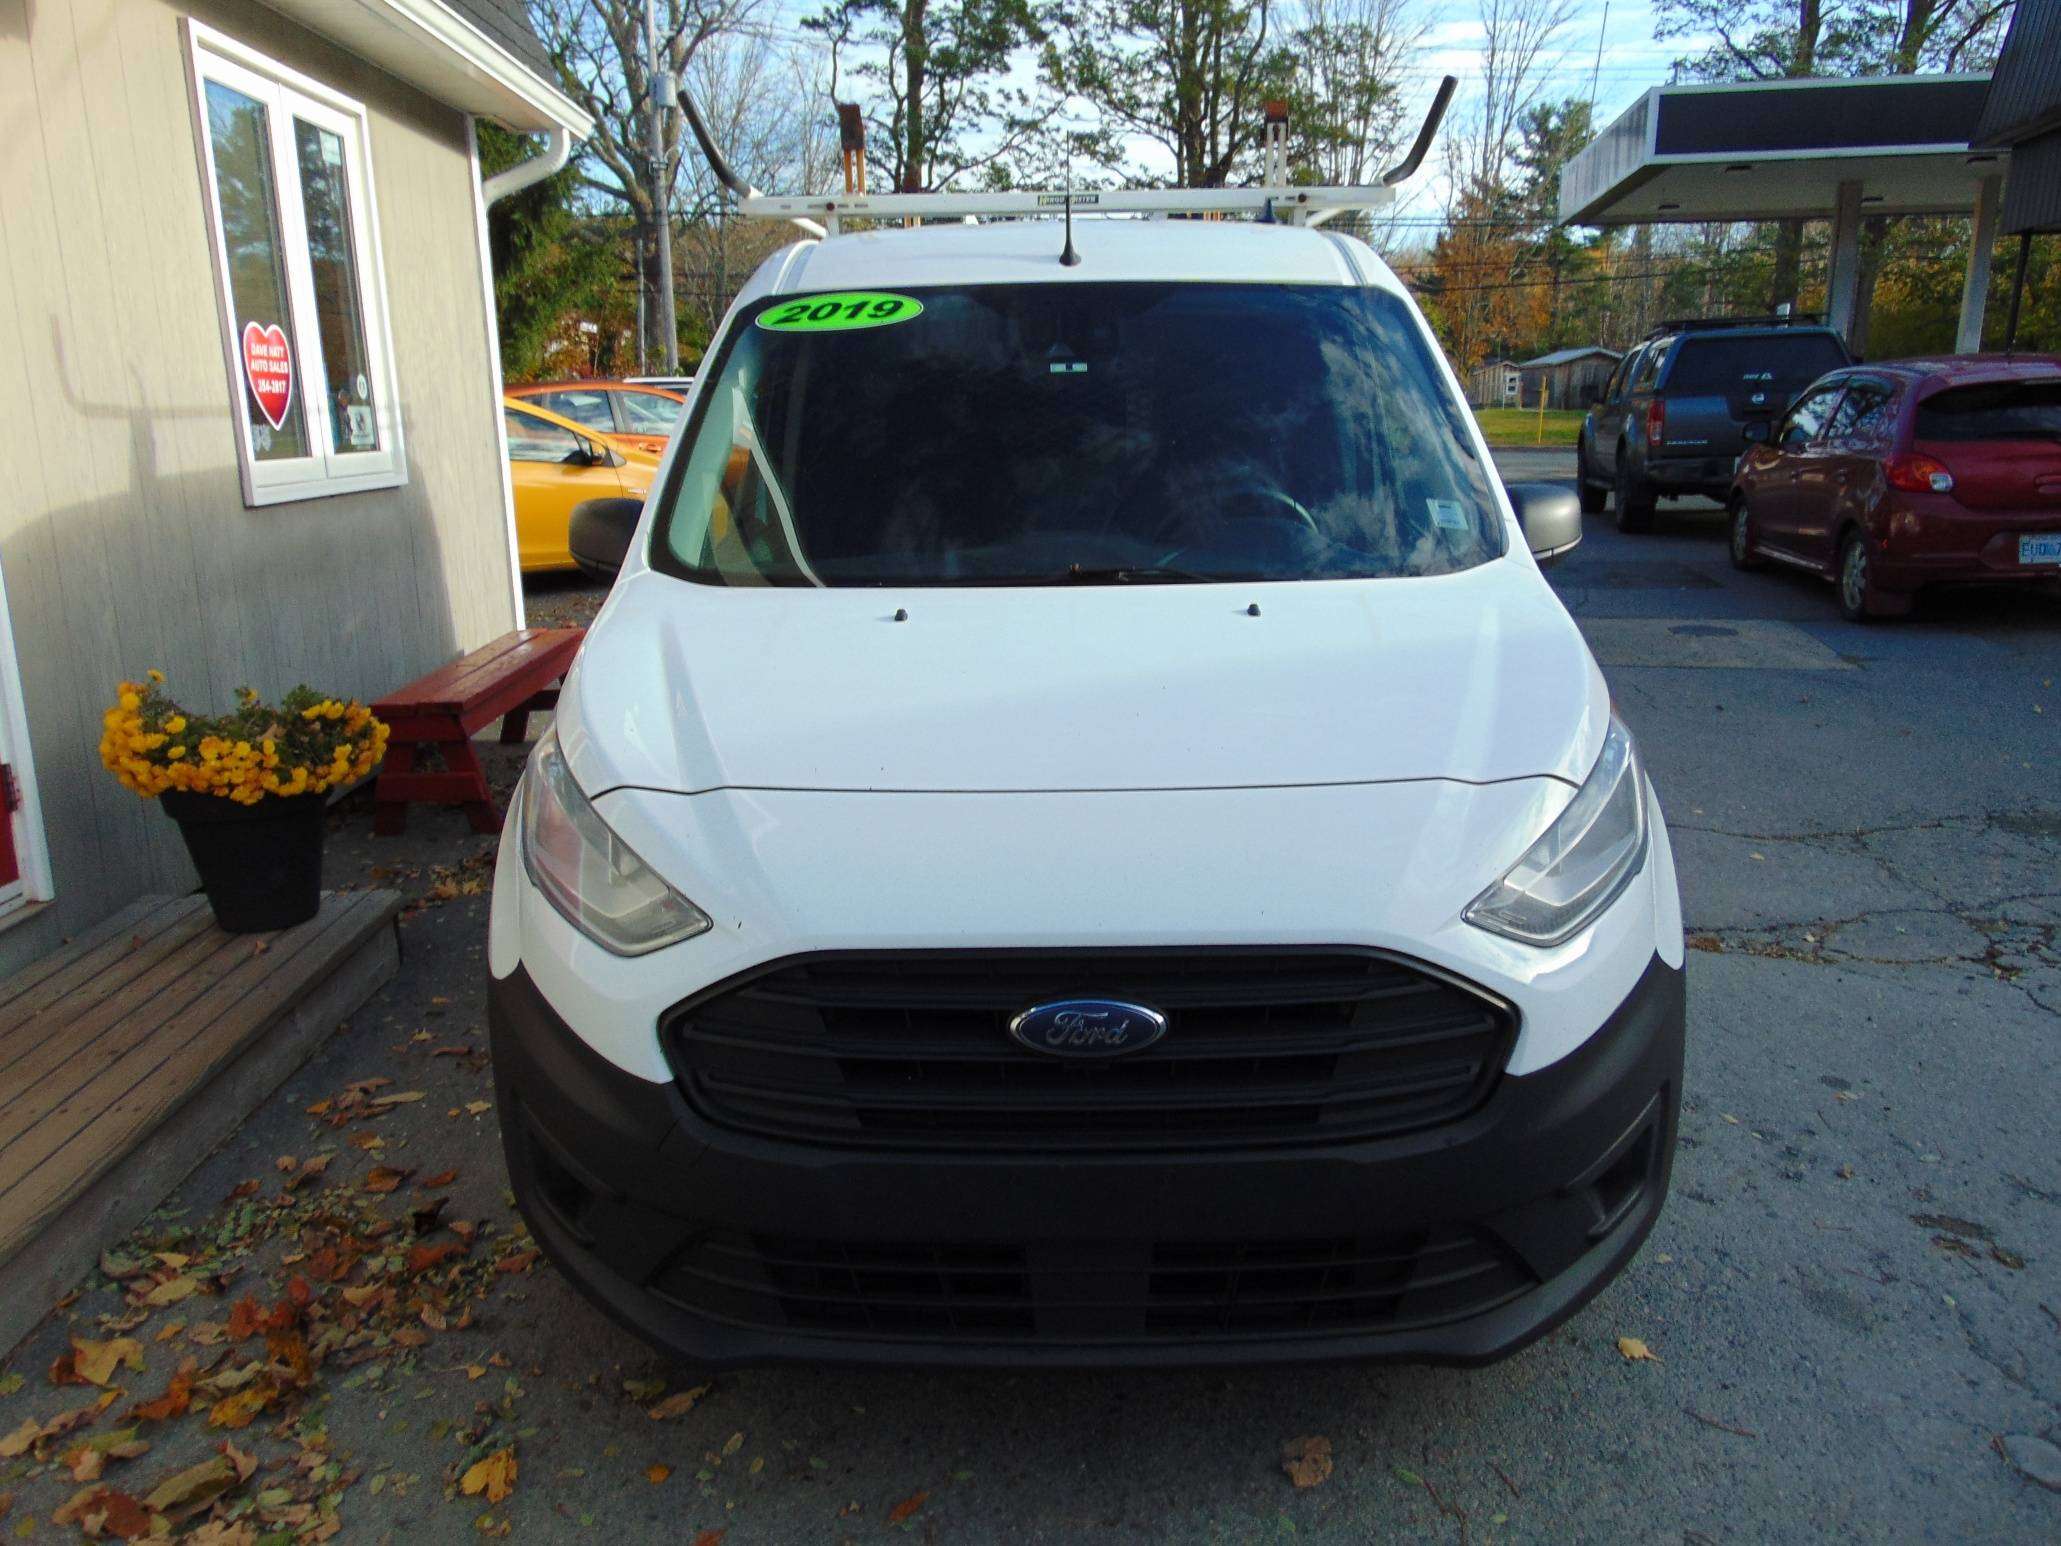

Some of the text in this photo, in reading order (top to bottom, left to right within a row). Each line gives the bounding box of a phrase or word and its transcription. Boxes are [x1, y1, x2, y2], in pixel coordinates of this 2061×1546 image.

[772, 300, 904, 325] 2019
[251, 343, 268, 356] DAVE
[250, 359, 288, 374] AUTO SALES
[1046, 1010, 1130, 1045] Ford
